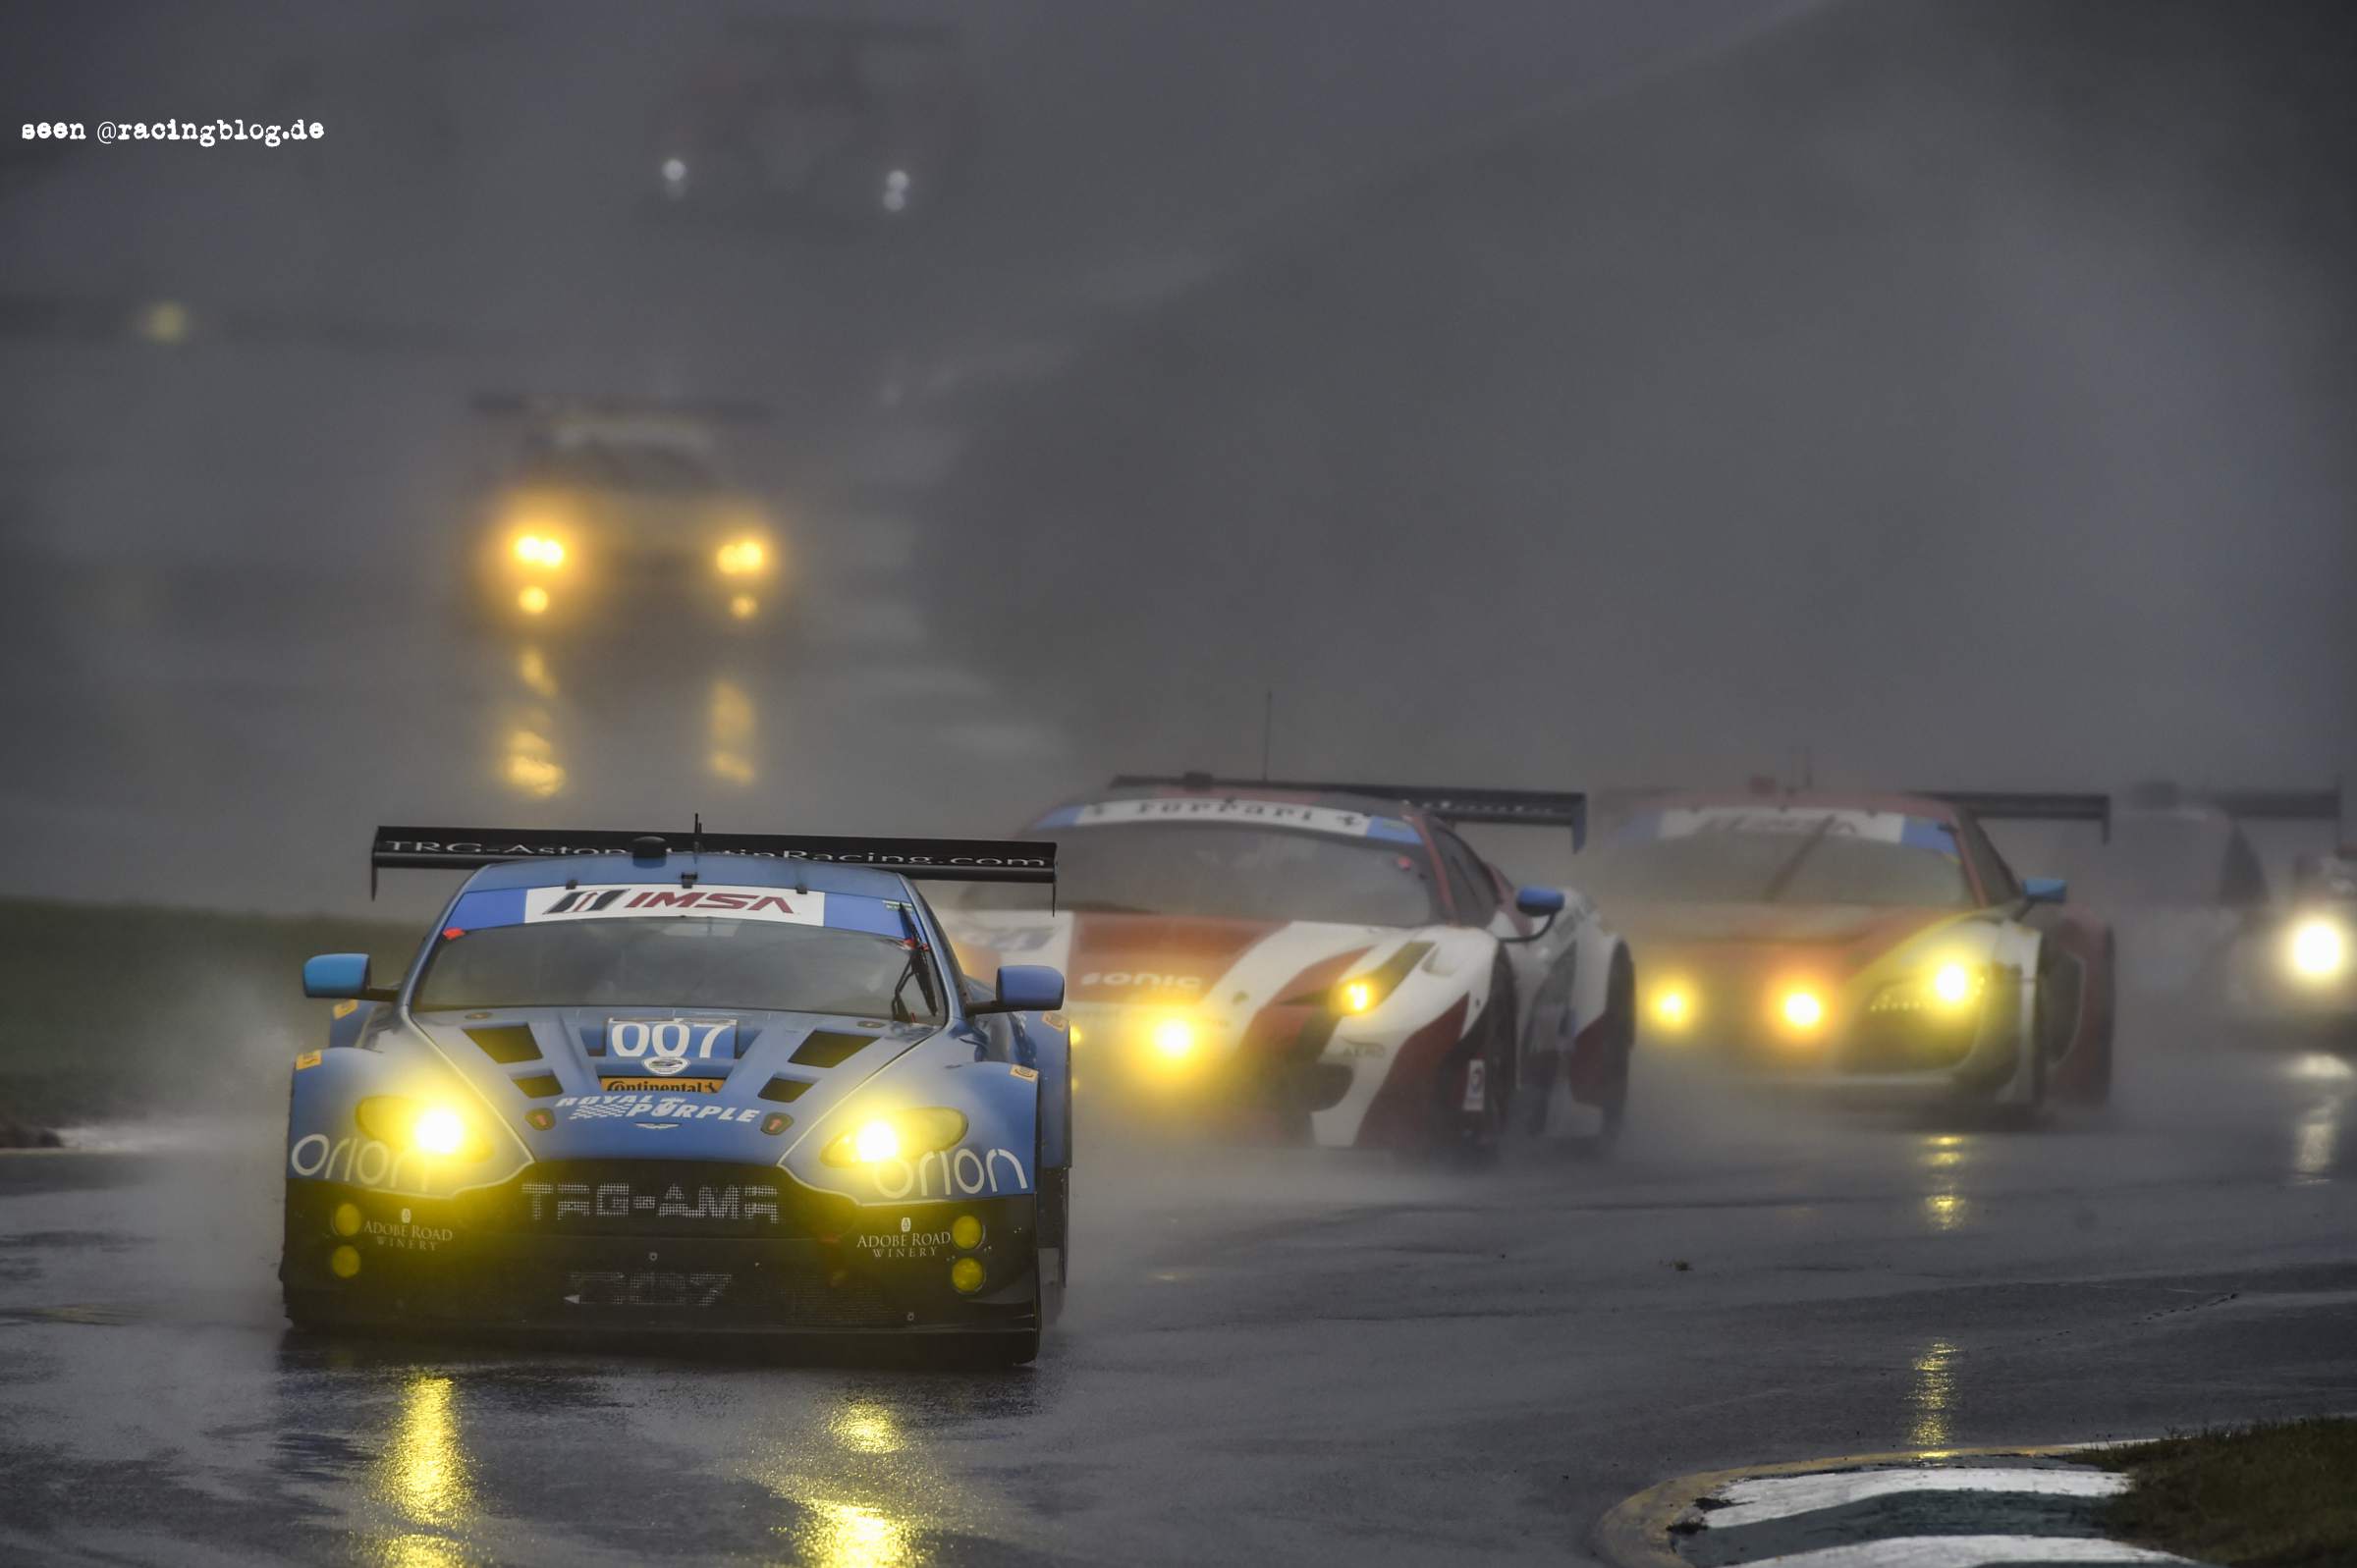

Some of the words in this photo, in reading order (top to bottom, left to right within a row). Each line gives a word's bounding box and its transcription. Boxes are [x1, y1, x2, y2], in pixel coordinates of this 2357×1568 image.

[625, 892, 794, 913] IMSA
[611, 1022, 731, 1058] 007
[606, 1081, 703, 1093] Continental
[555, 1094, 654, 1108] ROYAL
[625, 1103, 761, 1123] PURPLE
[873, 1148, 1028, 1199] orion
[521, 1182, 779, 1224] TRG-AMR
[364, 1220, 409, 1236] ADOBE
[411, 1224, 453, 1241] ROAD
[856, 1234, 907, 1248] ADOBE
[911, 1231, 951, 1246] ROAD
[377, 1235, 439, 1252] WINERY
[873, 1247, 939, 1258] WINERY
